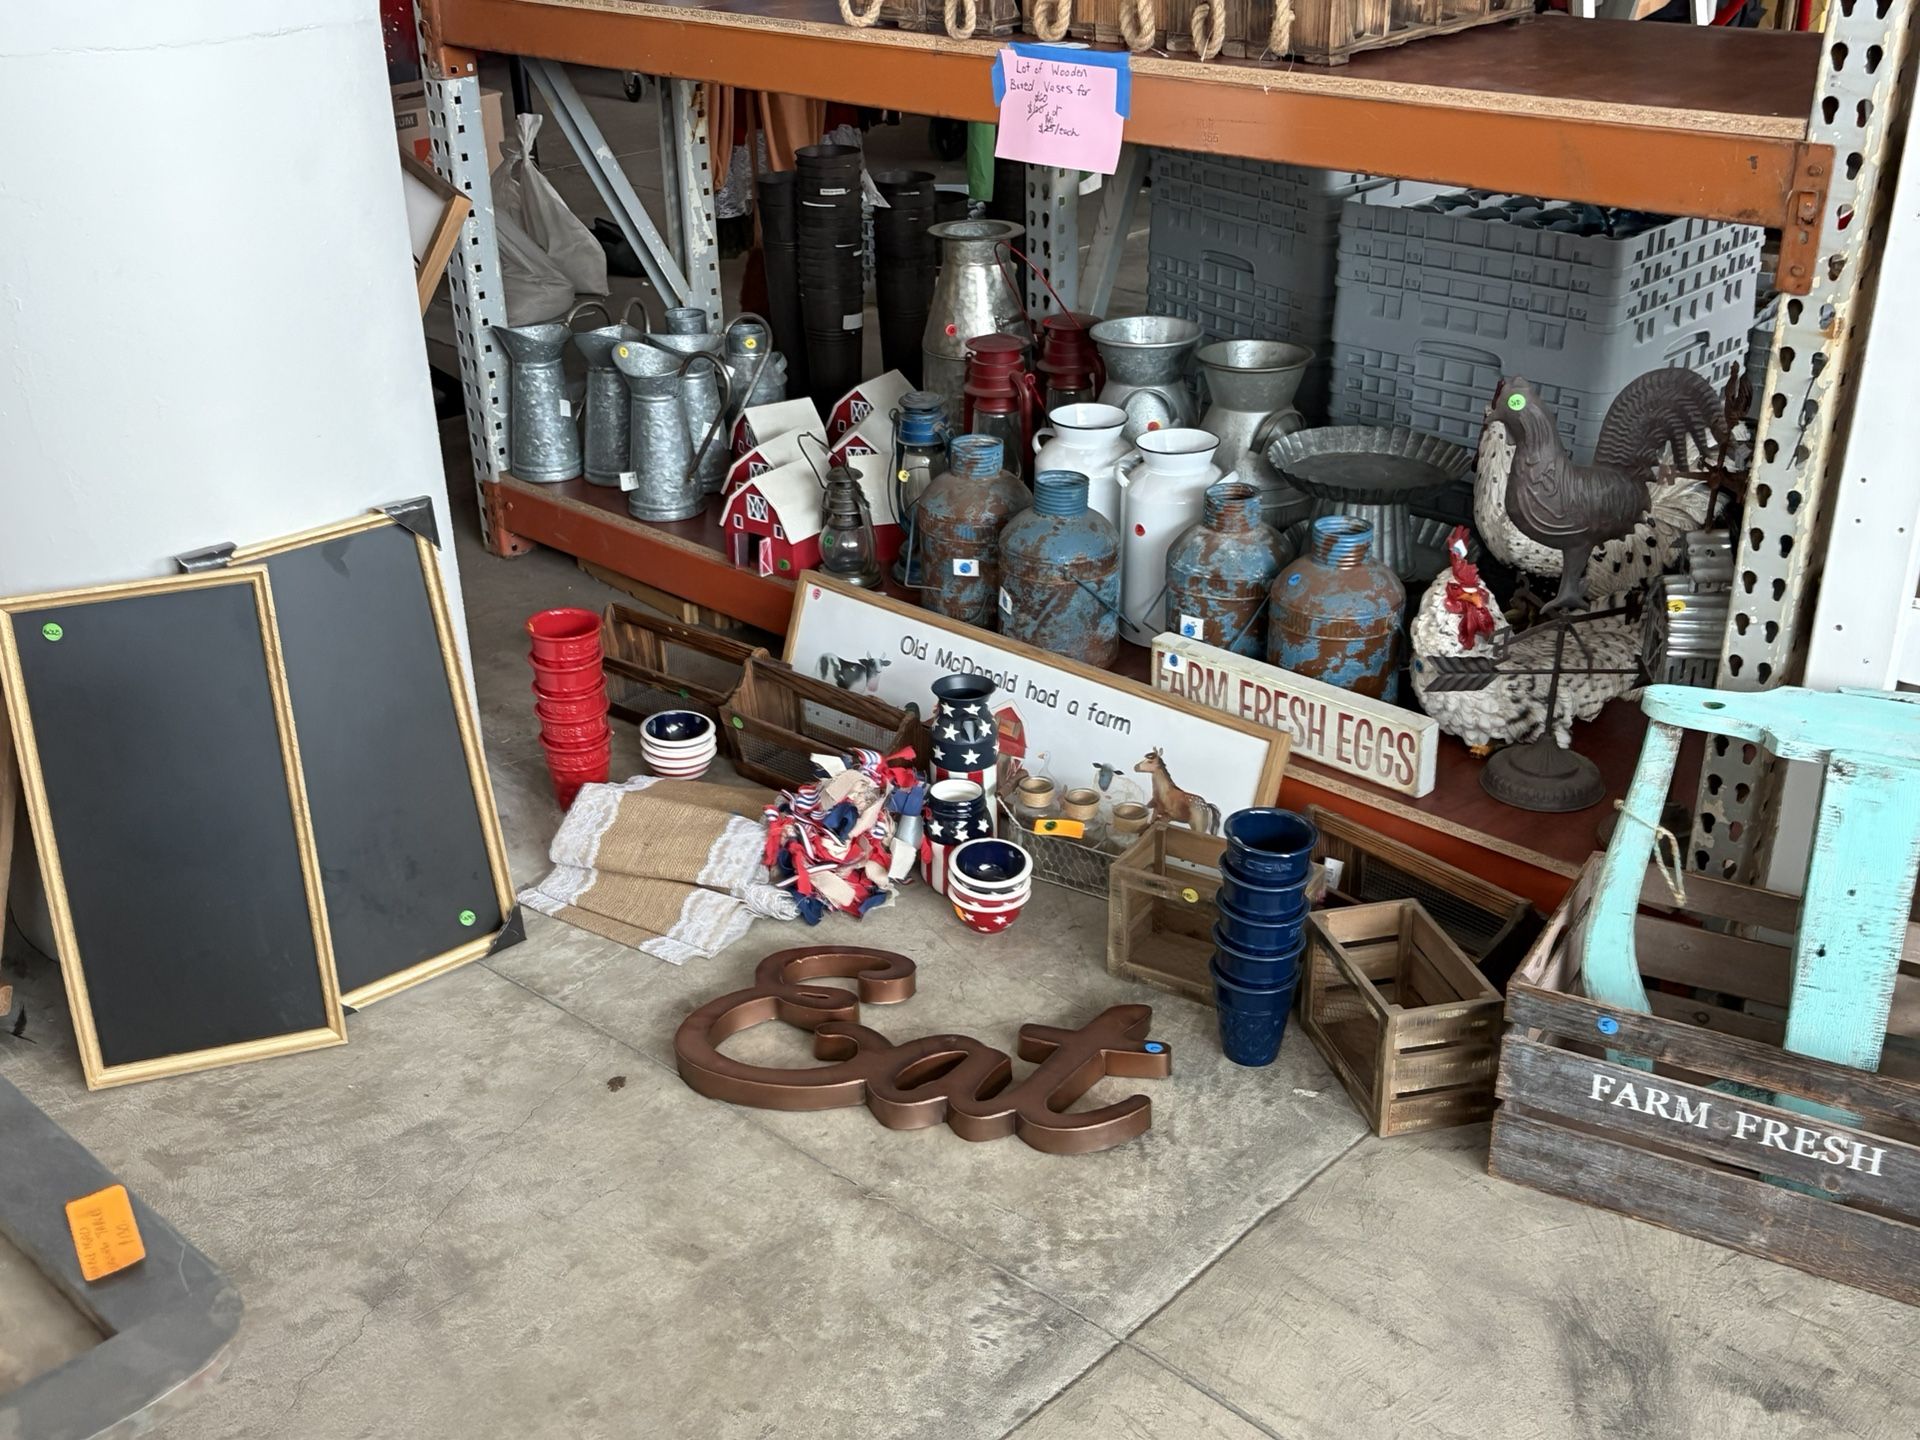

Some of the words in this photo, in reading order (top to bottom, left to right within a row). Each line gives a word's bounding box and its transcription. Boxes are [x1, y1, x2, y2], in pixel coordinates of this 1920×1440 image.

[1015, 60, 1032, 74] Lot
[1034, 62, 1044, 74] of
[1051, 64, 1088, 78] Wooden
[1043, 81, 1073, 95] Vases
[1077, 85, 1091, 96] for
[900, 635, 929, 661] Old
[935, 648, 1018, 693] McDonald
[1025, 680, 1060, 709] had
[1067, 699, 1079, 717] a
[1087, 702, 1132, 736] farm
[1156, 651, 1229, 711] FARM
[1239, 679, 1327, 757] FRESH
[1336, 713, 1416, 786] EGGS
[674, 945, 1173, 1155] Eat
[1587, 1074, 1711, 1129] FARM
[1731, 1109, 1888, 1177] FRESH
